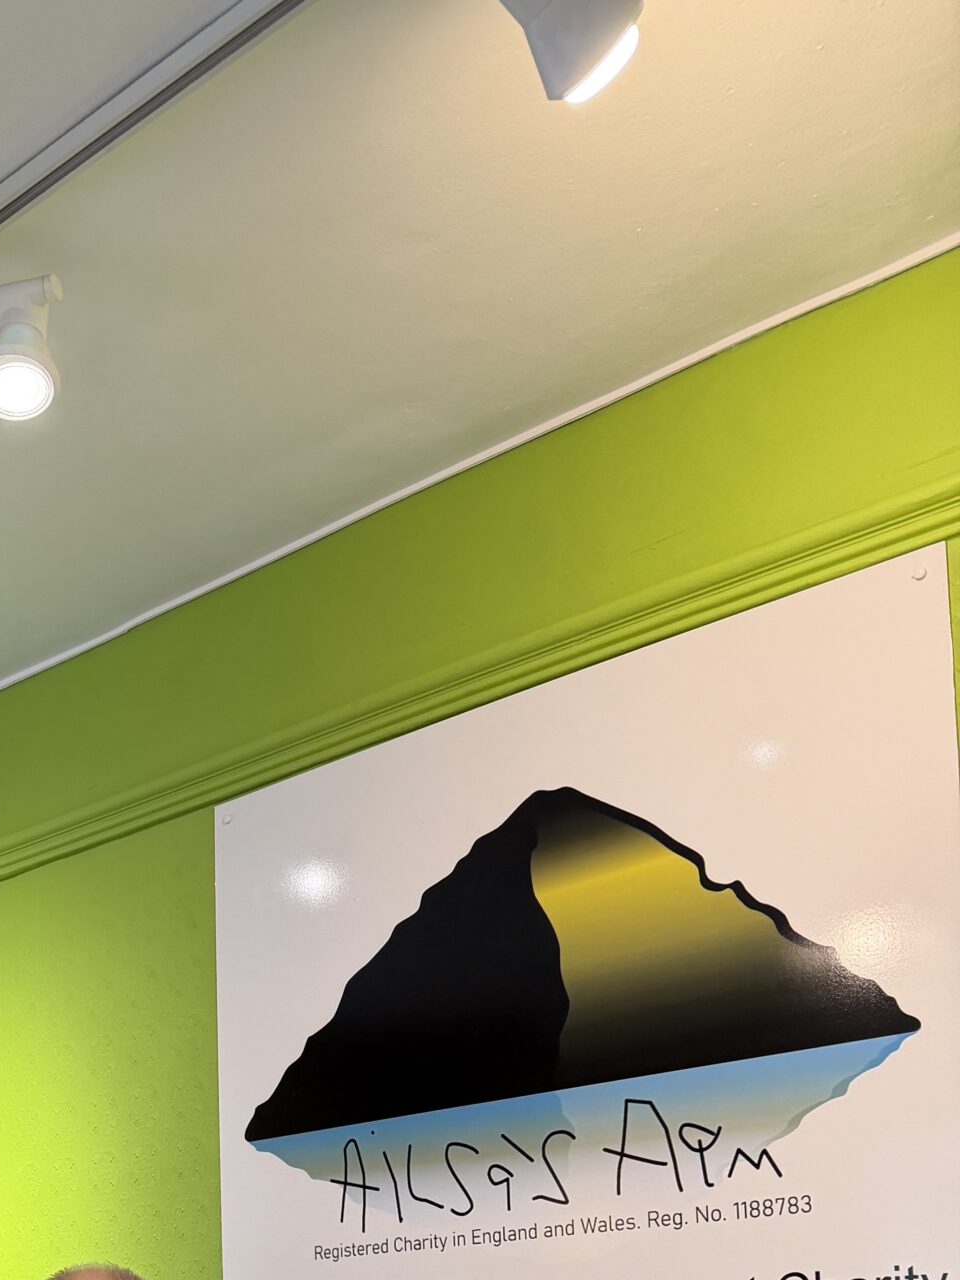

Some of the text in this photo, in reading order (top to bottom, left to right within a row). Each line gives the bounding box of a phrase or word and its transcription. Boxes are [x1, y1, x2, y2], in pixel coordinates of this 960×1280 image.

[314, 1194, 813, 1263] Registered Charity in England and Wales. Reg. No. 1188783
